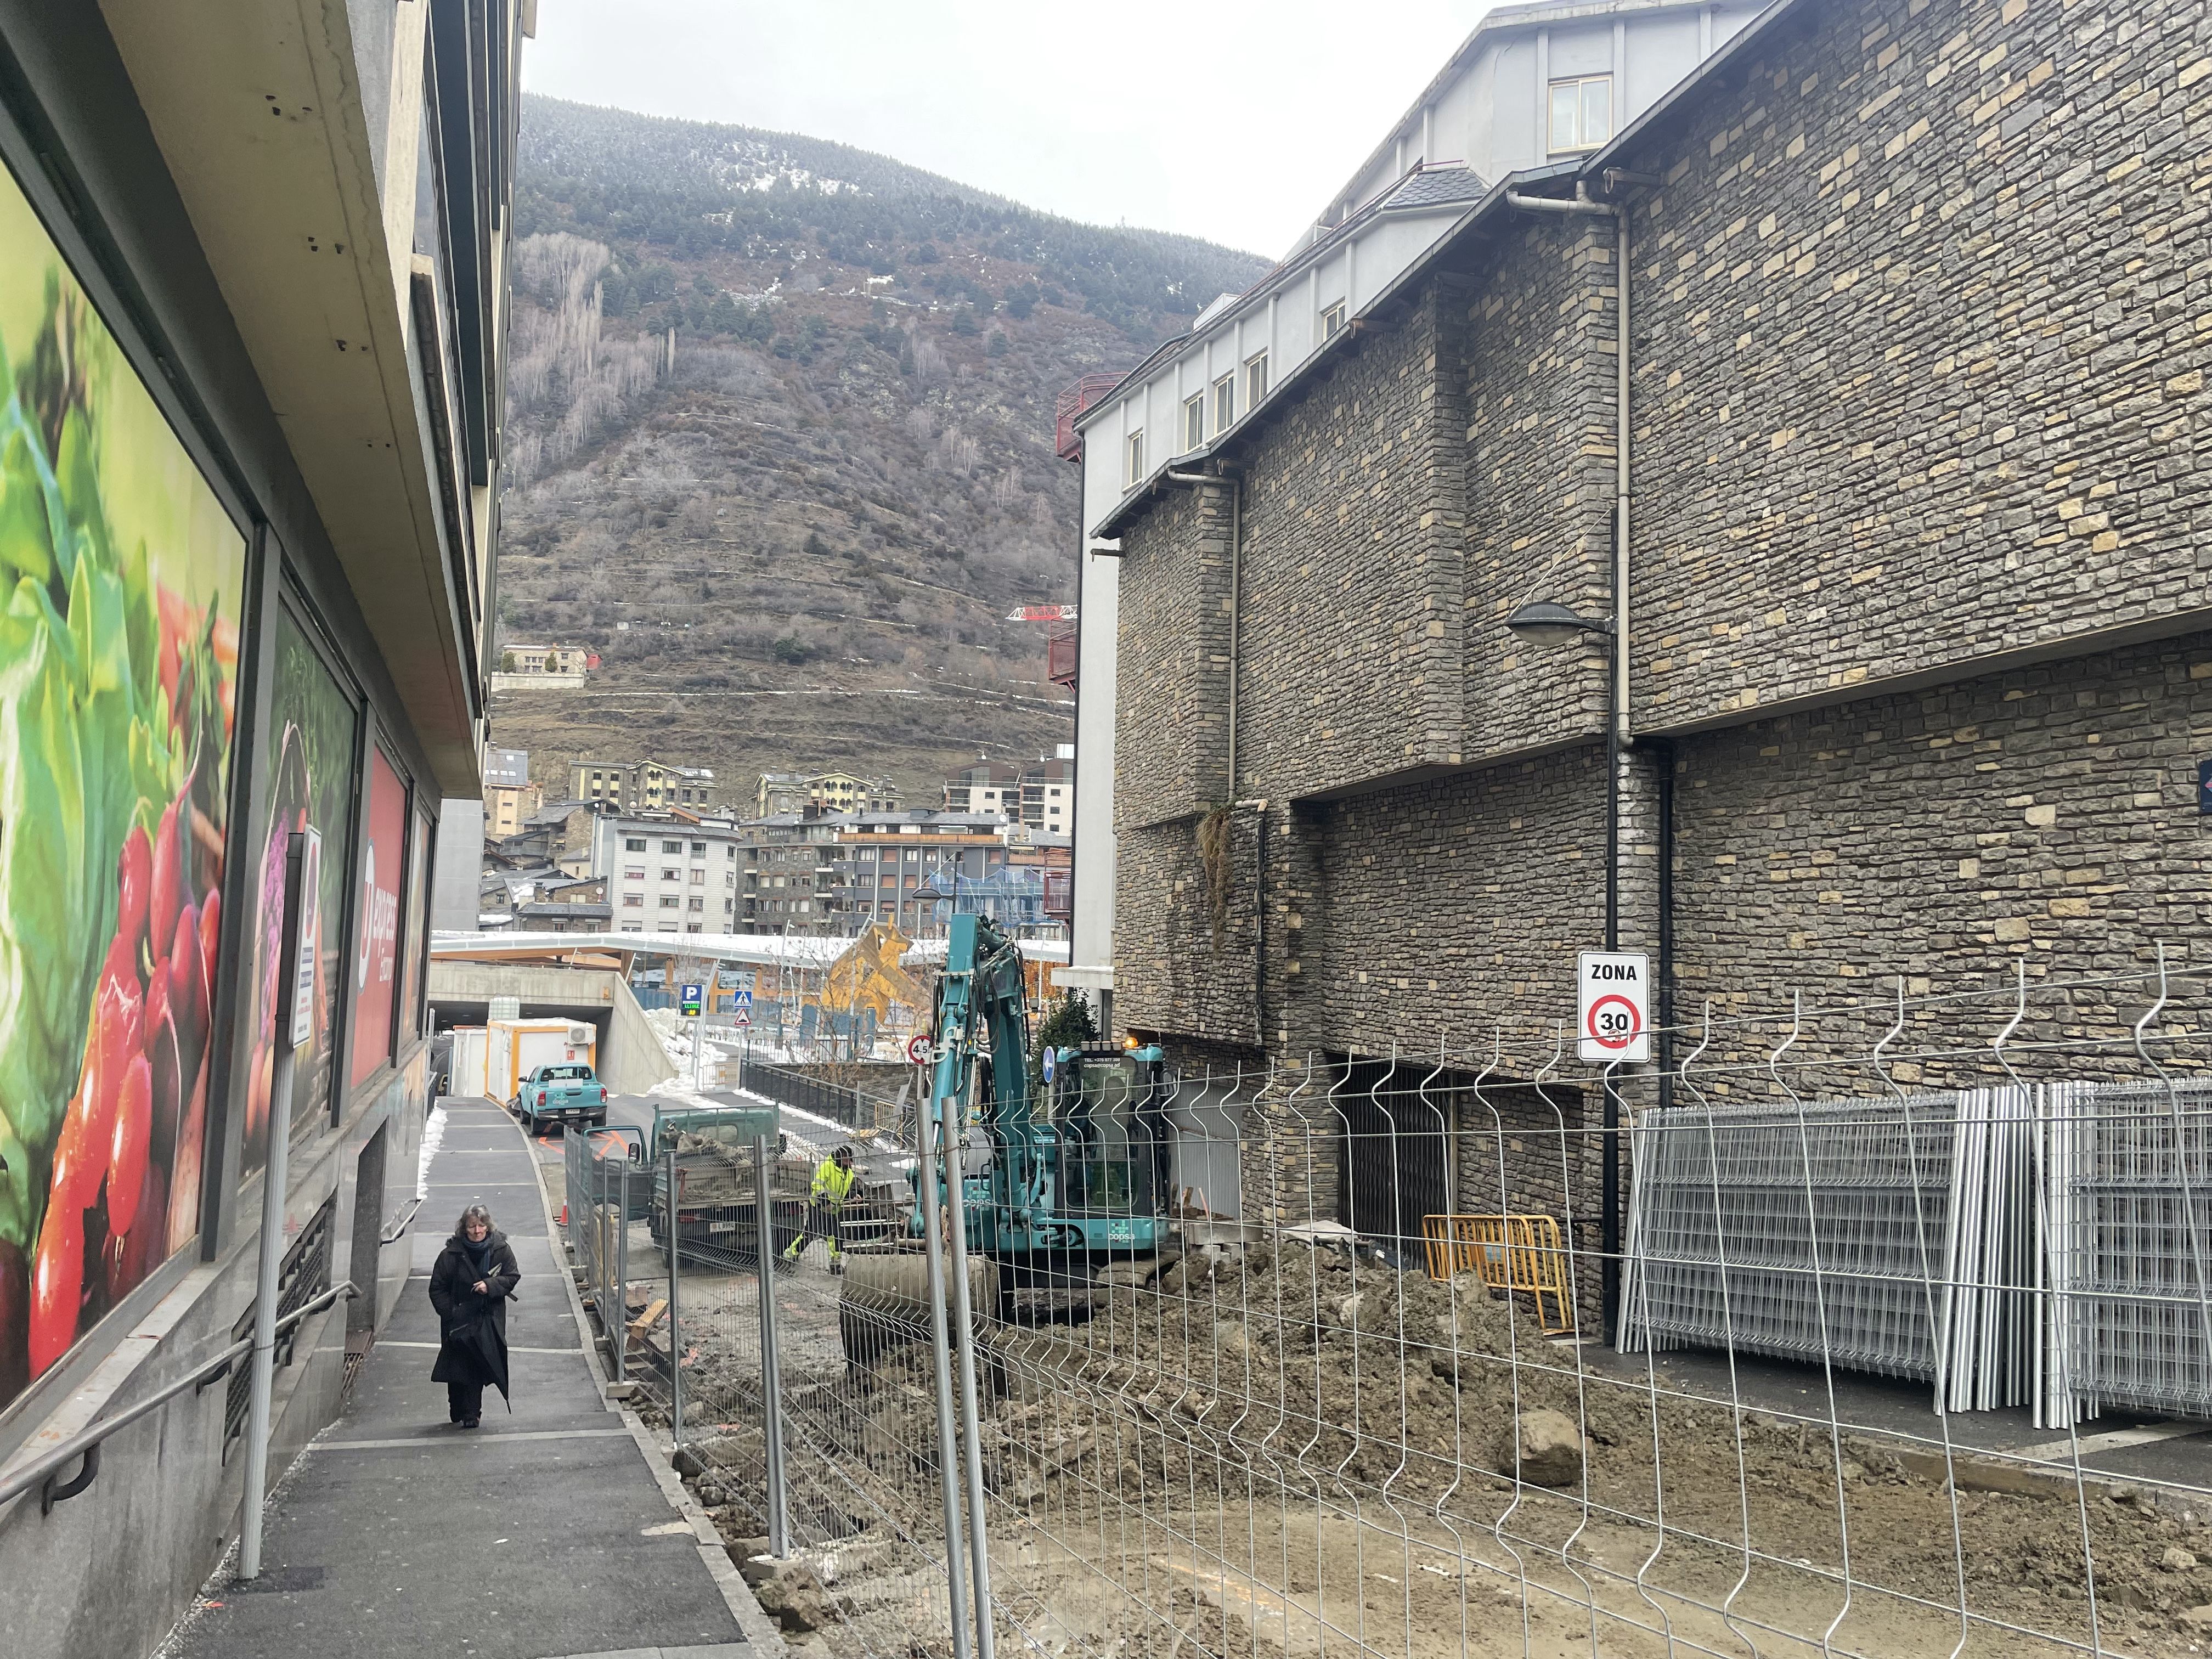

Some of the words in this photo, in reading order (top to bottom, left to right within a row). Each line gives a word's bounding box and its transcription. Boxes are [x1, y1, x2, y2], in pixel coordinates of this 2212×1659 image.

[373, 887, 397, 958] express
[1592, 964, 1637, 980] ZONA
[686, 987, 697, 999] P
[1600, 1013, 1628, 1030] 30
[963, 1199, 998, 1209] copsa
